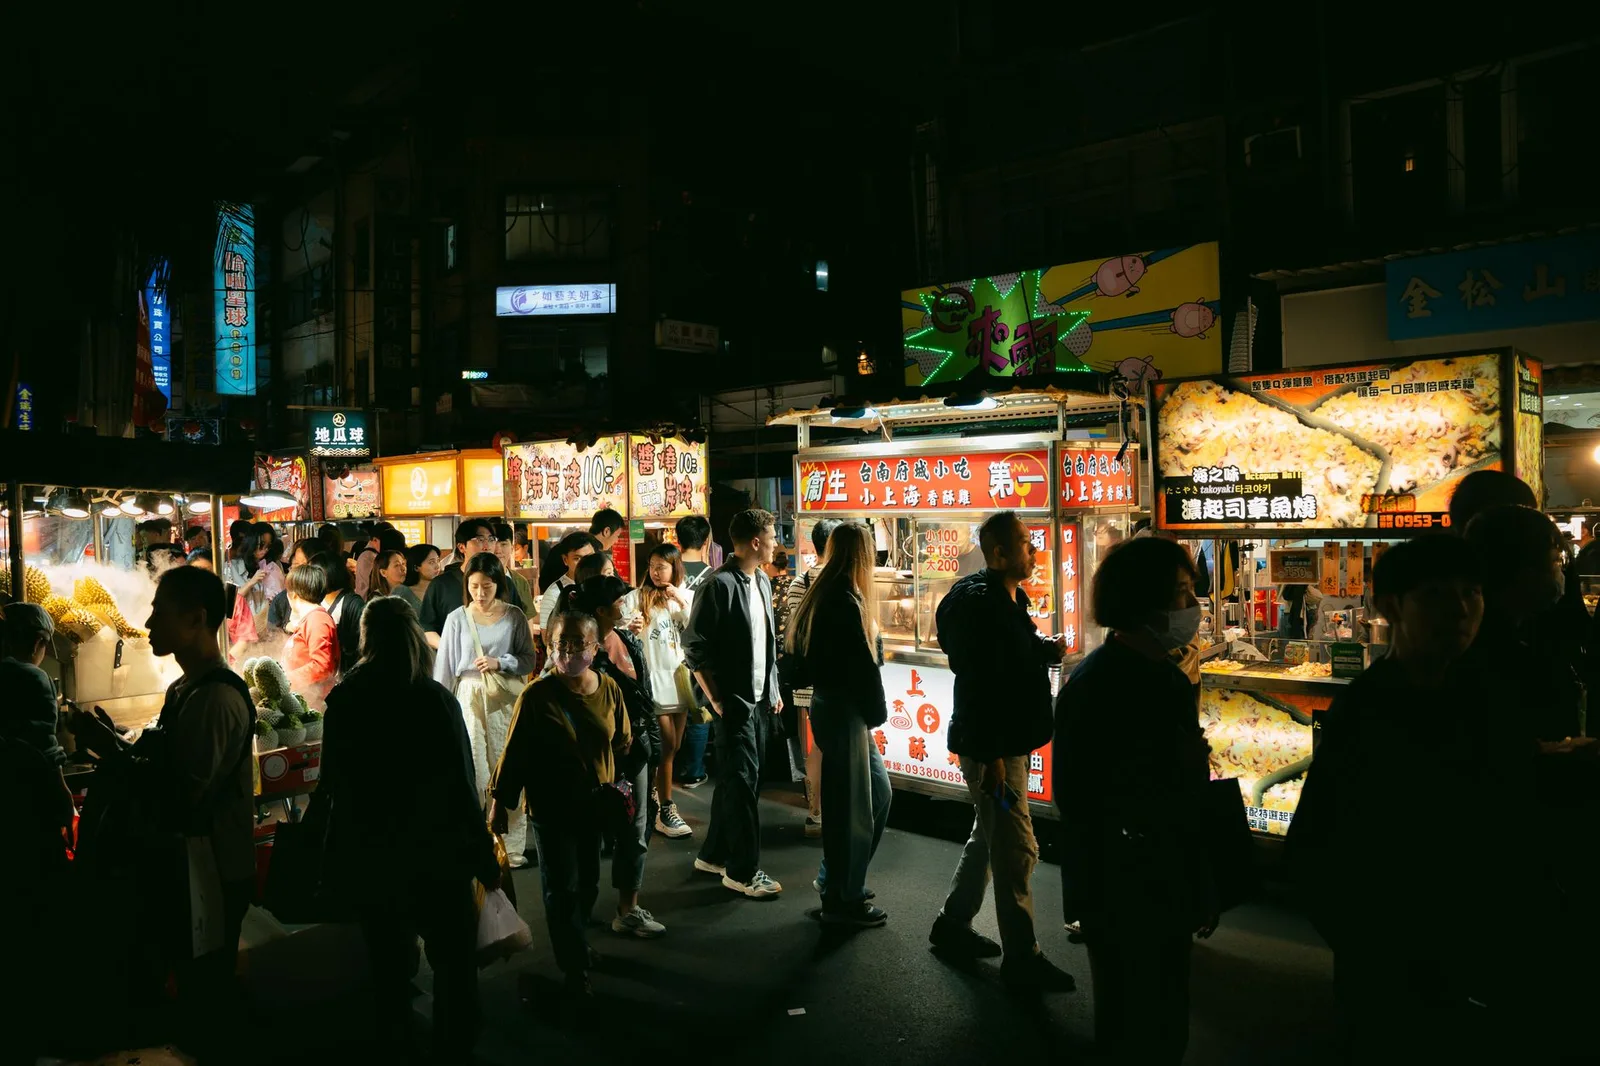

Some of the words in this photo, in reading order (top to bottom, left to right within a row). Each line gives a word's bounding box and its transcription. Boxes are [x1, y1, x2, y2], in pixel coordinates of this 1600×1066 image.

[315, 427, 364, 443] 地瓜球
[859, 456, 972, 484] 台南府城小吃
[988, 461, 1045, 500] 第一
[1193, 467, 1240, 483] 海之味
[1166, 486, 1199, 495] たこやき
[1200, 484, 1235, 495] takoyaki
[1235, 483, 1272, 495] 타코야키
[1181, 496, 1318, 521] 濃起司章魚燒
[1062, 529, 1076, 648] 口味獨特
